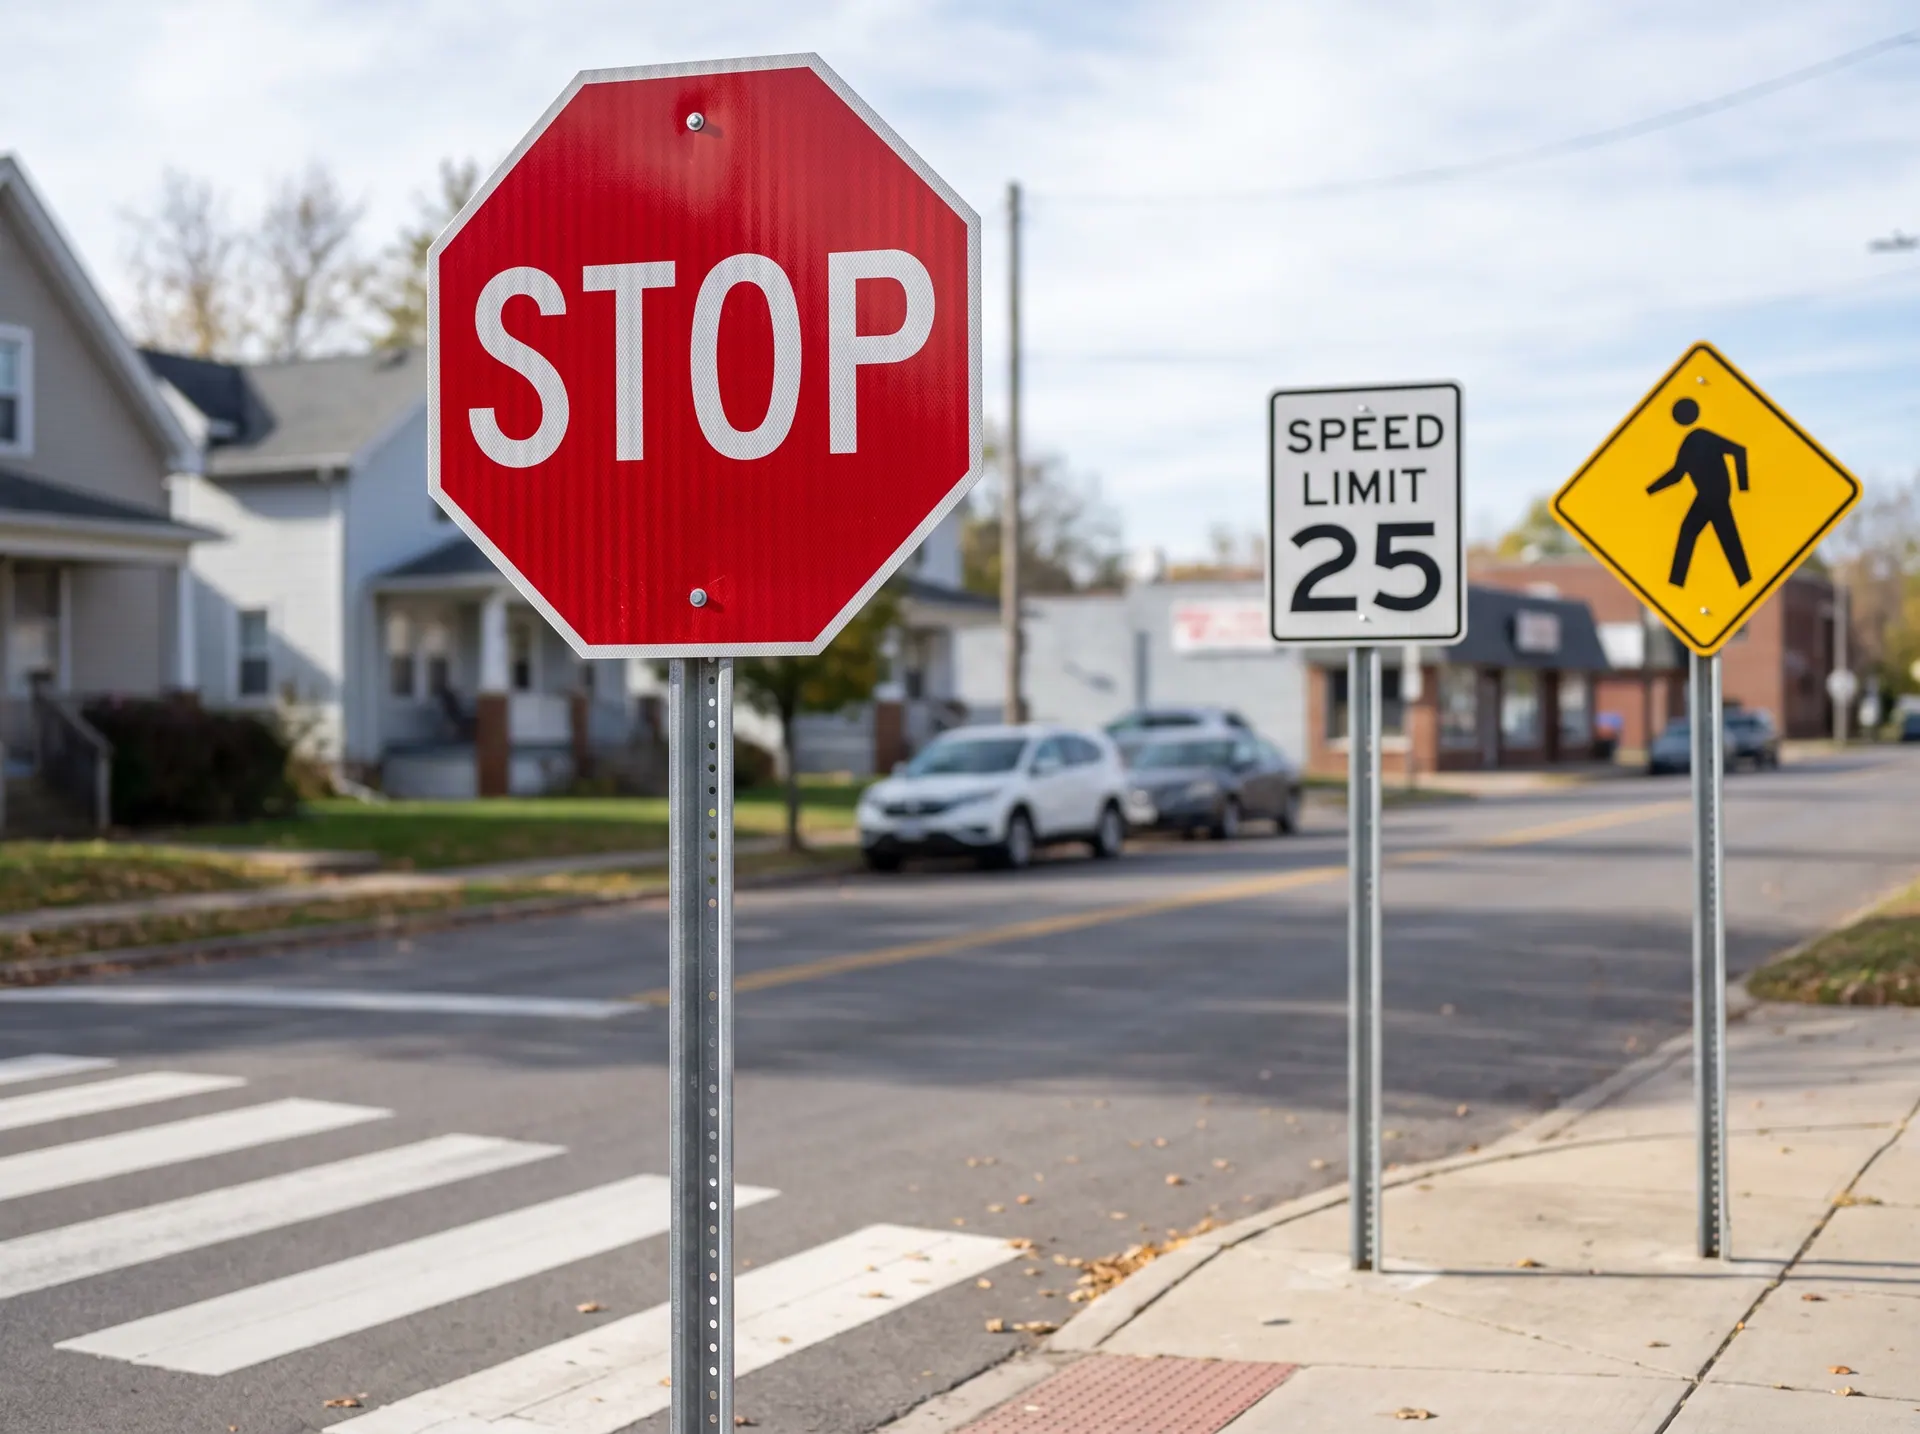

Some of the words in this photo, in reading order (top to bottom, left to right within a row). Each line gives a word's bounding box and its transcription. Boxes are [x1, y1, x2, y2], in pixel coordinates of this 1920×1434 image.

[468, 248, 937, 469] STOP
[1287, 414, 1445, 454] SPEED
[1303, 468, 1427, 506] LIMIT
[1290, 521, 1442, 613] 25
